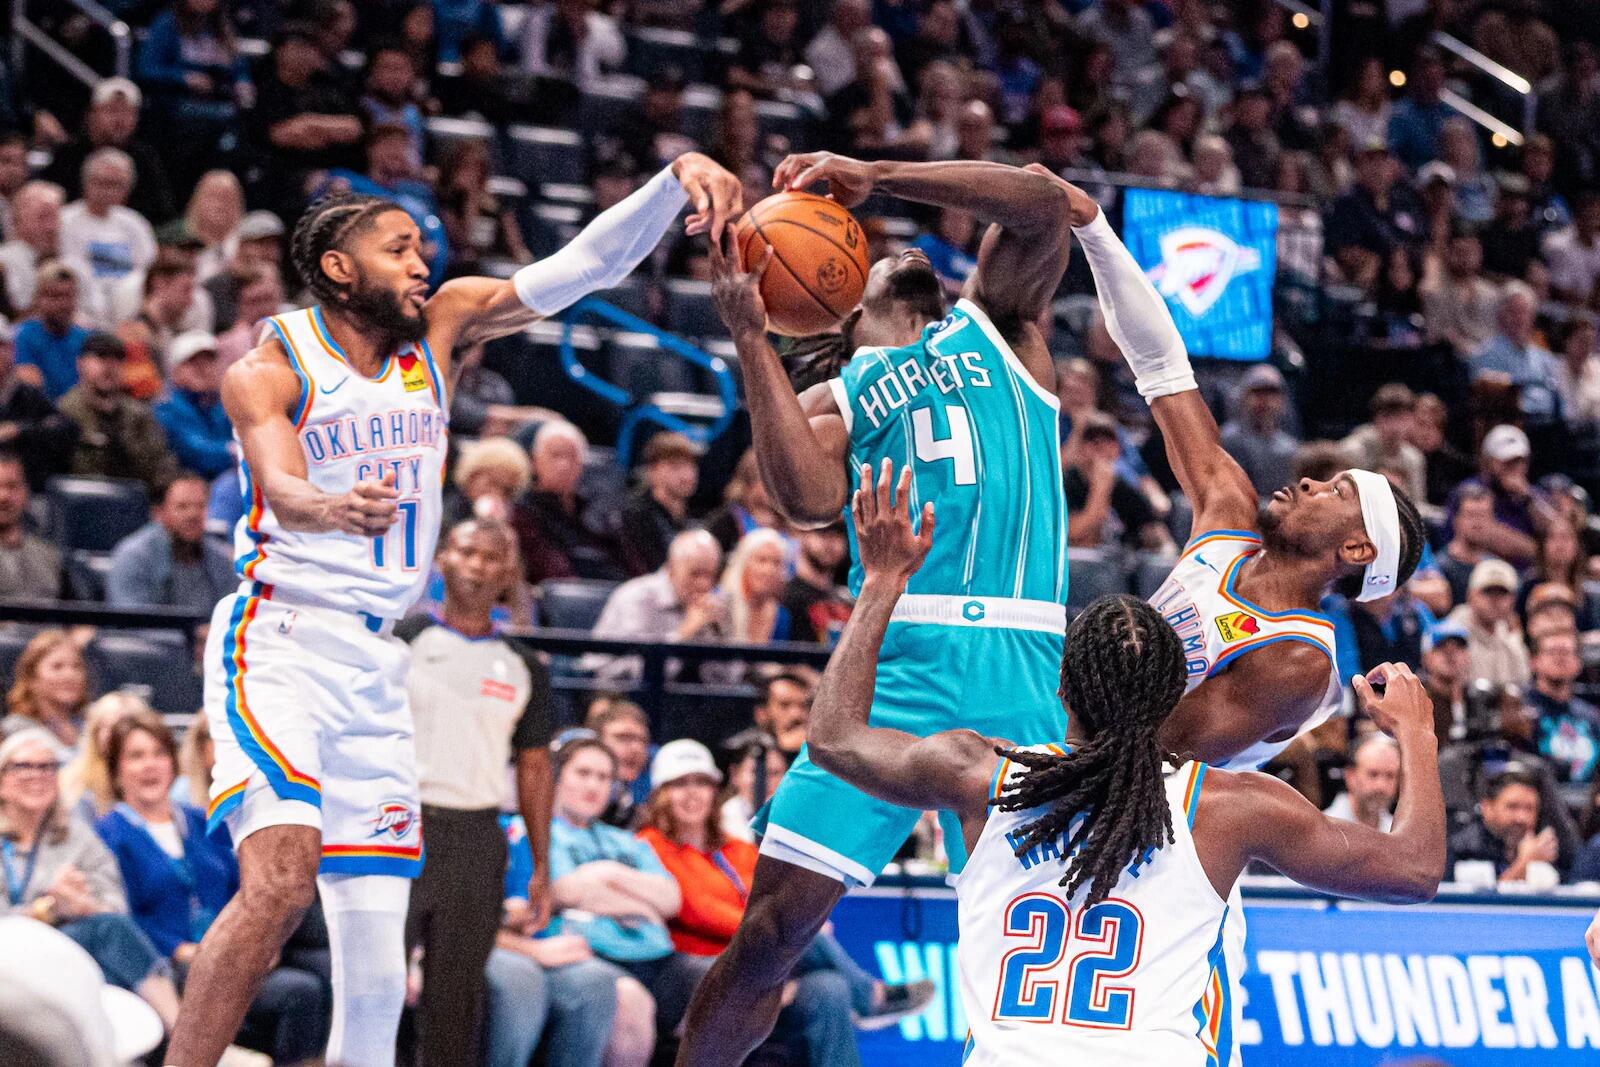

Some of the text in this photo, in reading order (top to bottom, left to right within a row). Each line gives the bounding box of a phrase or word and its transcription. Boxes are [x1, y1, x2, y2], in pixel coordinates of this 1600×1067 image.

[858, 351, 993, 429] HORETS
[911, 404, 978, 486] 4
[992, 892, 1144, 1030] 22
[1257, 950, 1559, 1049] THUNDER
